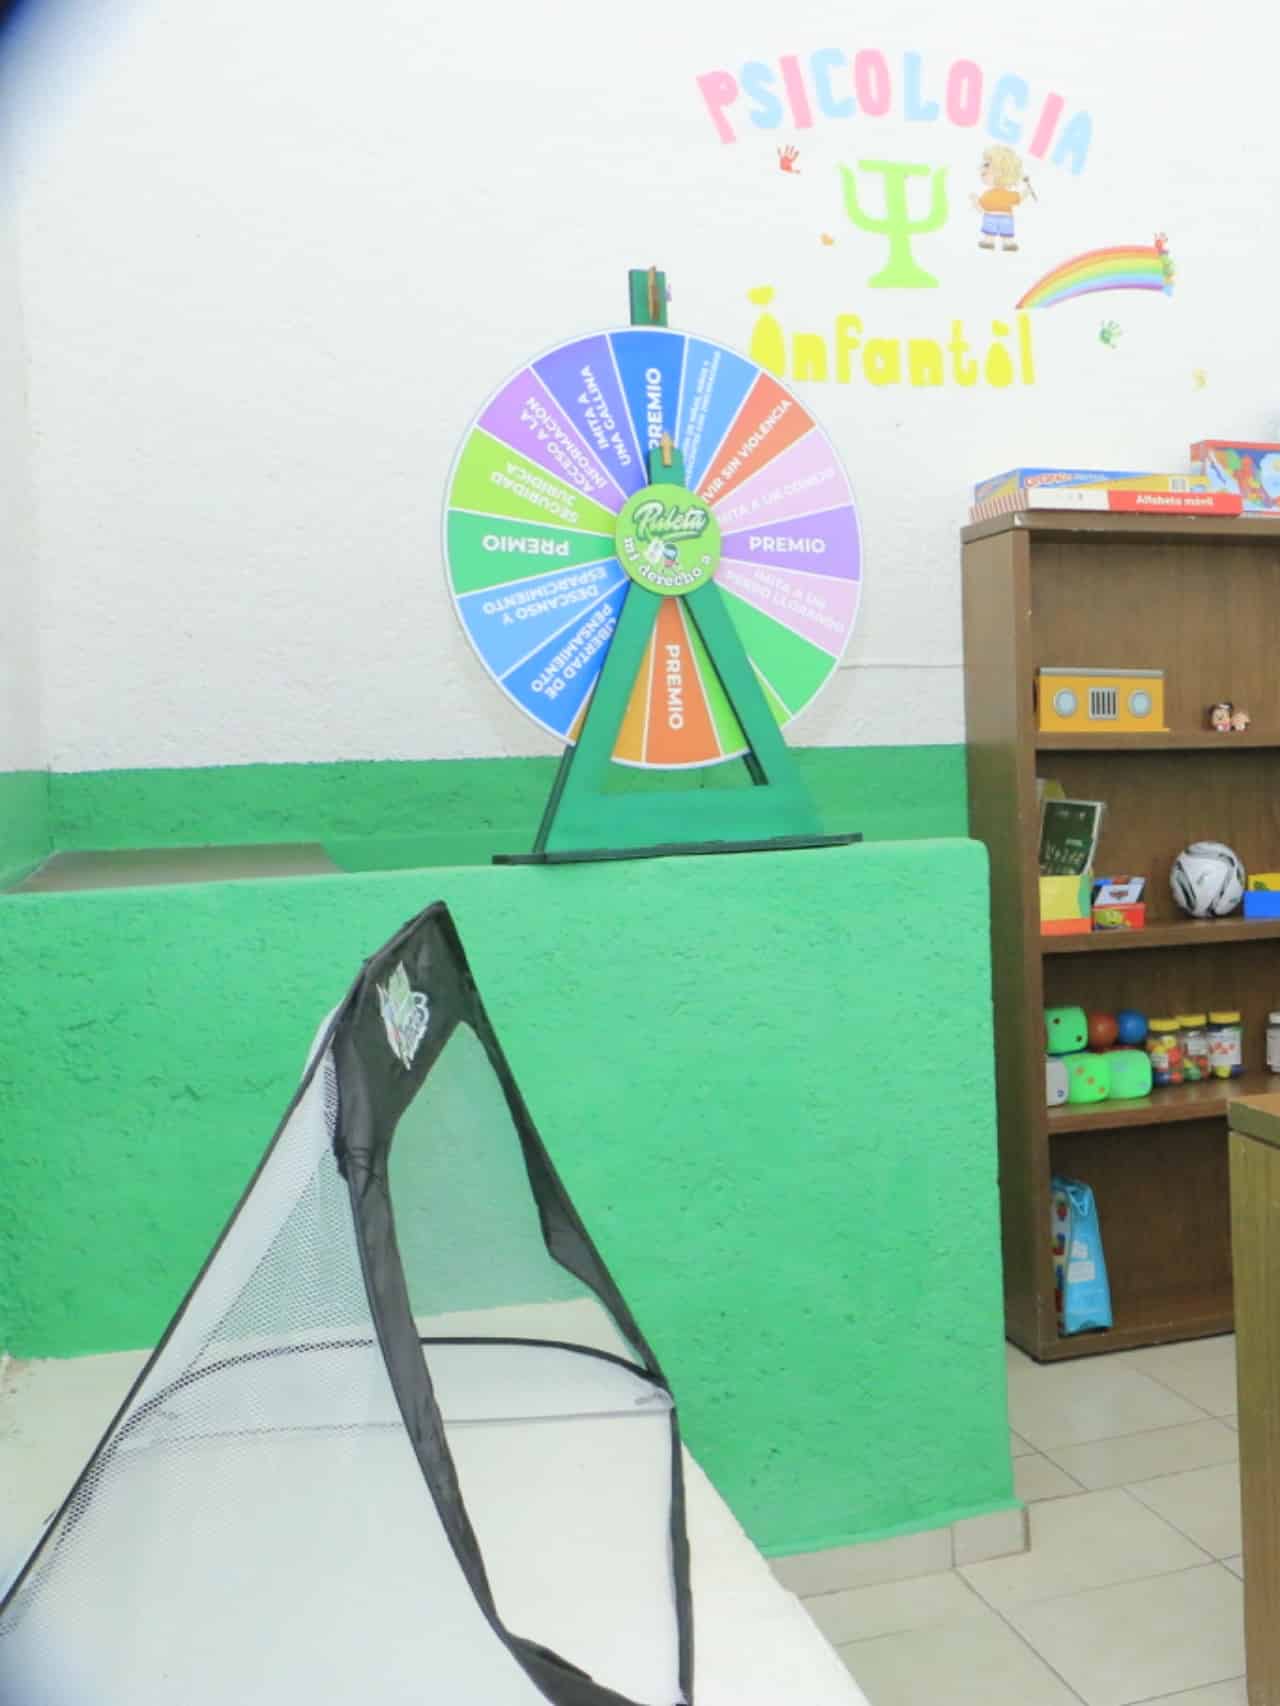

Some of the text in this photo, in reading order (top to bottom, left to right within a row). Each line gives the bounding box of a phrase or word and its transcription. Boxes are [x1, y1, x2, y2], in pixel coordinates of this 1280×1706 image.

[696, 47, 1093, 175] PSICOLOGIA
[578, 393, 609, 450] IMITA A
[580, 365, 632, 466] UNA GALLINA
[723, 456, 743, 480] SIN
[738, 399, 793, 458] VIOLENCIA
[520, 410, 596, 492] ACCESO A LA
[1136, 494, 1182, 506] Alfabeto
[482, 535, 569, 557] PREMIO
[623, 536, 640, 560] mi
[639, 565, 702, 587] derecho
[750, 536, 826, 553] PREMIO
[482, 566, 608, 615] ESPARCIMIENTO
[502, 584, 599, 625] DESCANSO Y
[530, 603, 613, 692] PENSAMIENTO
[545, 617, 616, 699] LIBERTAD DE
[665, 644, 684, 730] PREMIO
